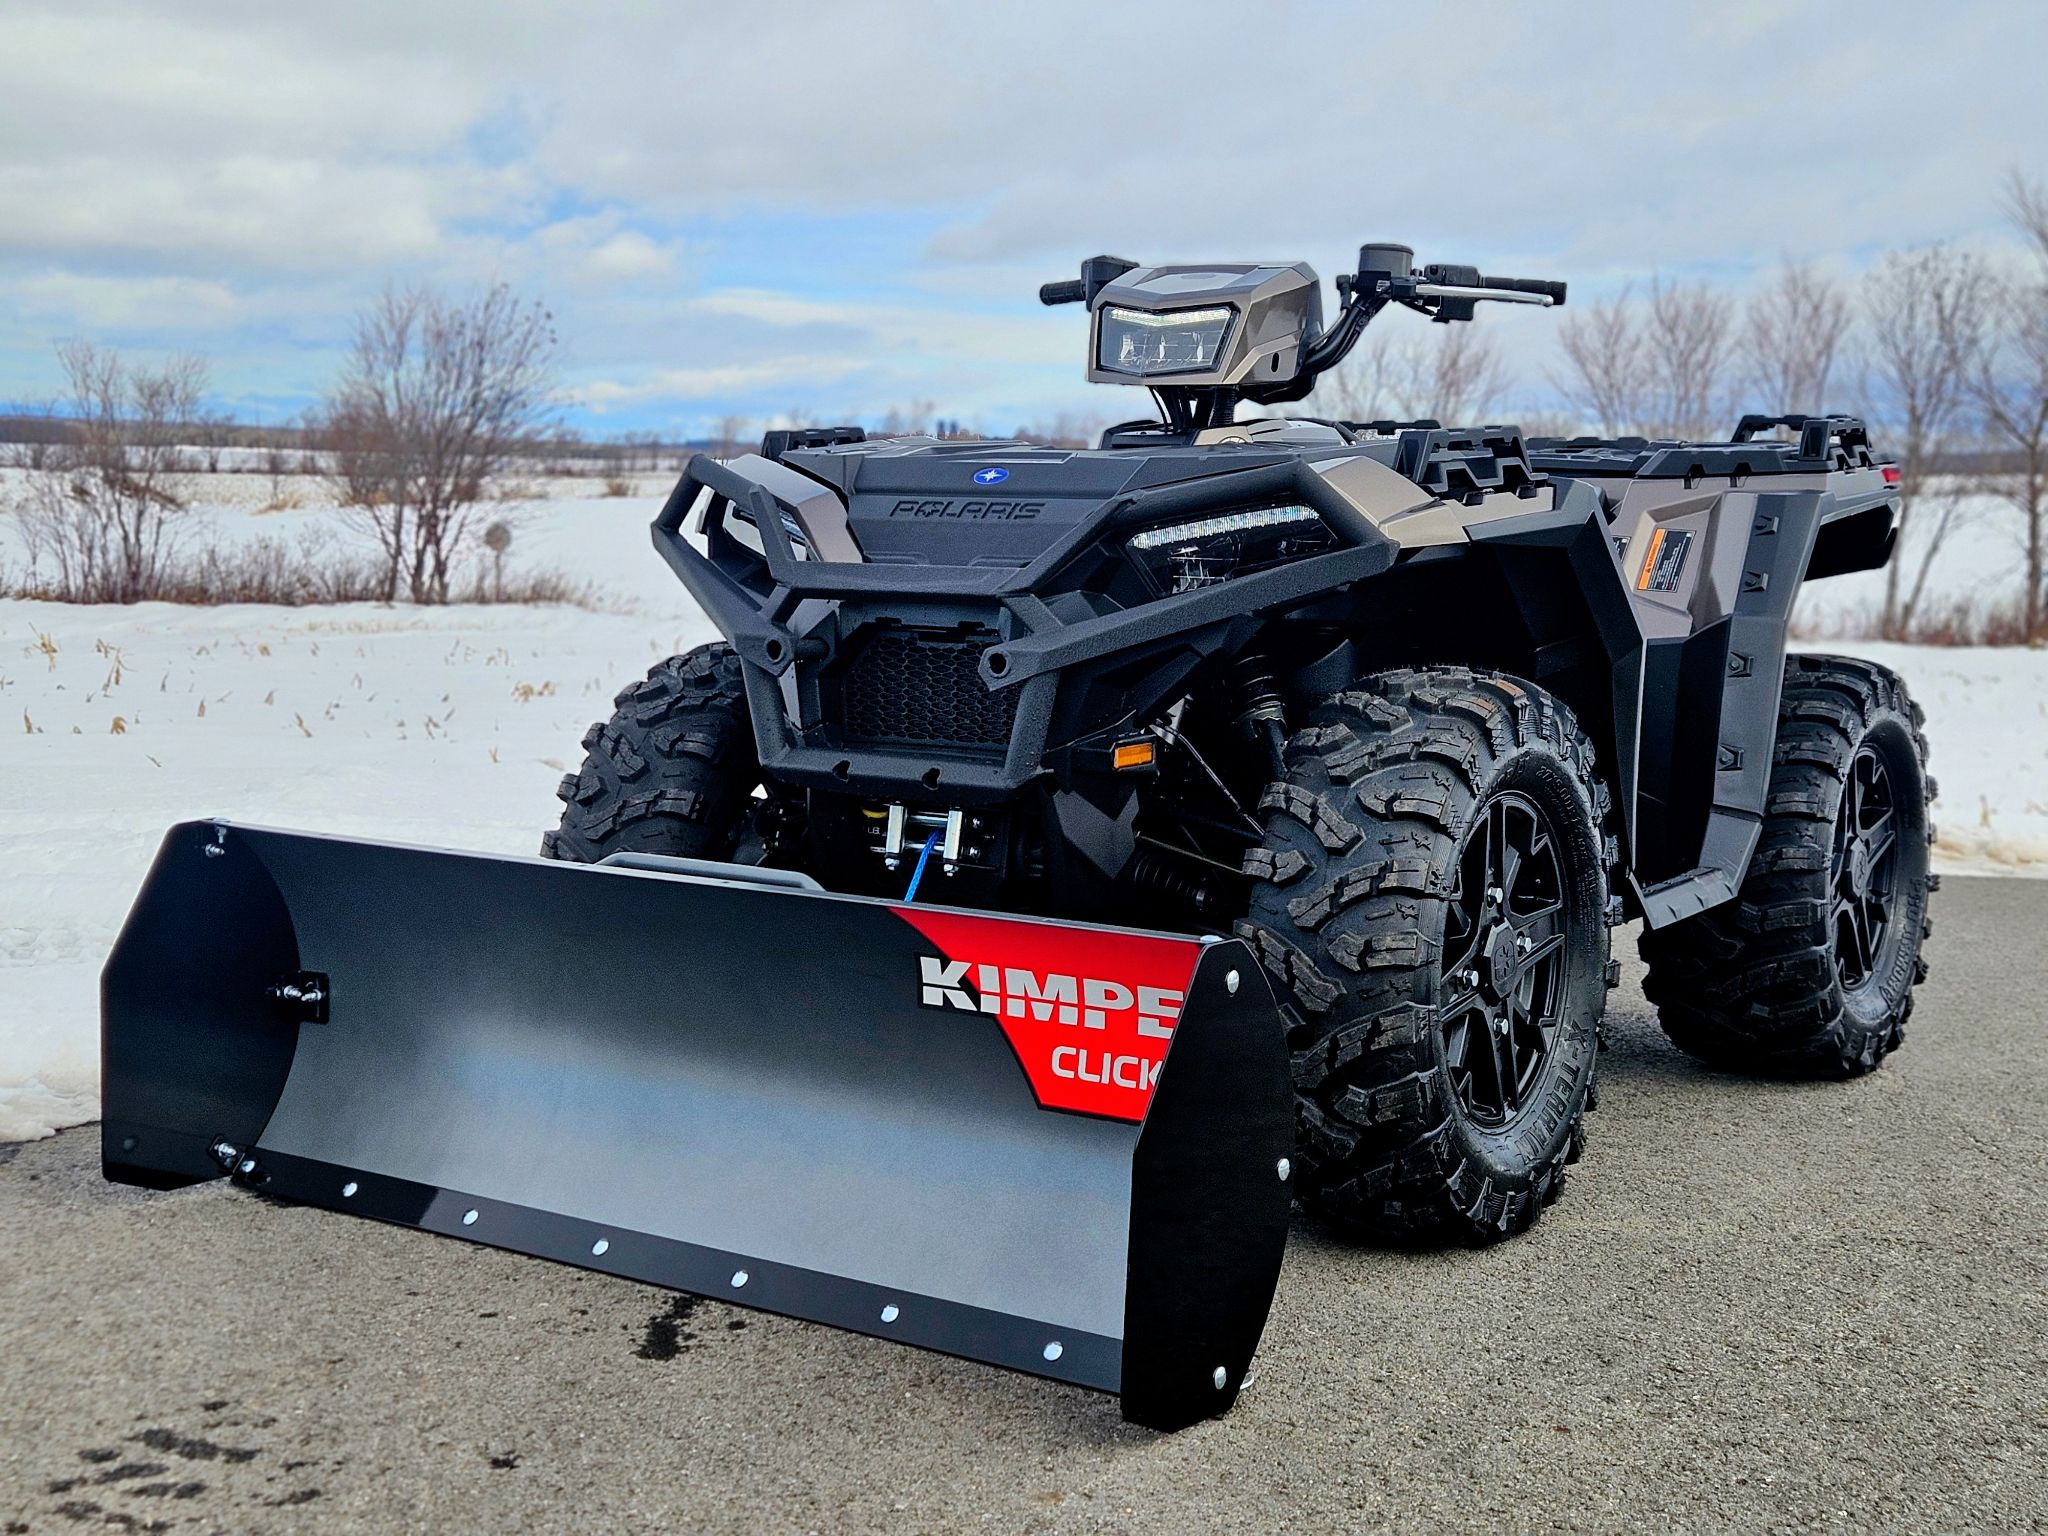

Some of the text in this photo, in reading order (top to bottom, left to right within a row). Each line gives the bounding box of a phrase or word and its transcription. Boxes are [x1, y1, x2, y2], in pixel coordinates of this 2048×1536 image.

[889, 500, 1047, 520] POLARIS
[919, 955, 1184, 1039] KIMPE
[1051, 1045, 1163, 1091] CLICK
[1514, 1018, 1590, 1165] X-TERRAIN
